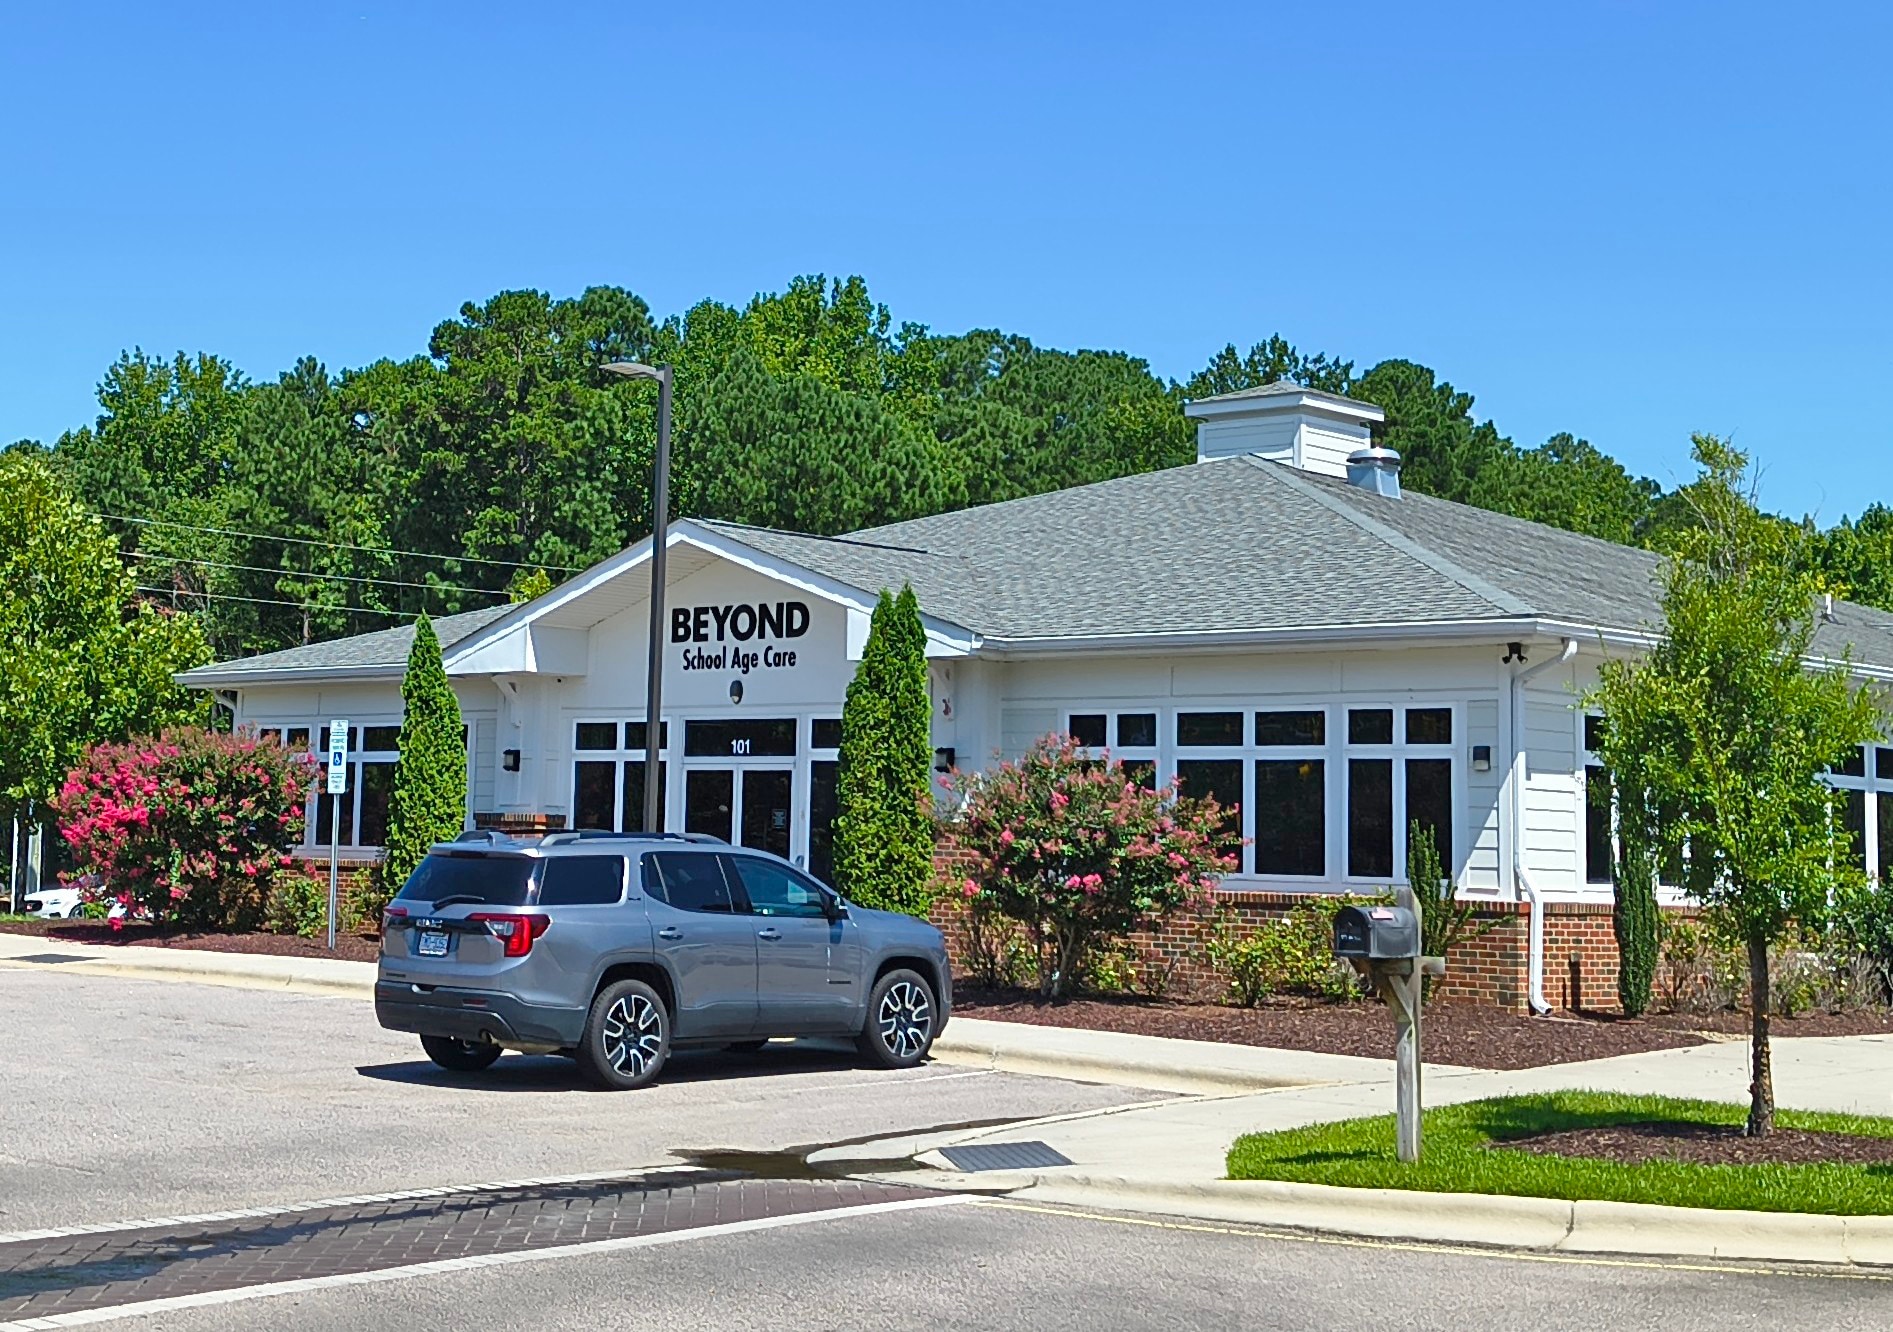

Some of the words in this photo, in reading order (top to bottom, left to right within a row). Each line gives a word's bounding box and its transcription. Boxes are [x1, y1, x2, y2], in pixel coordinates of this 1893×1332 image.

[671, 601, 810, 643] BEYOND
[683, 646, 726, 670] School
[731, 646, 759, 674] Age
[763, 645, 797, 667] Care
[731, 739, 750, 754] 101
